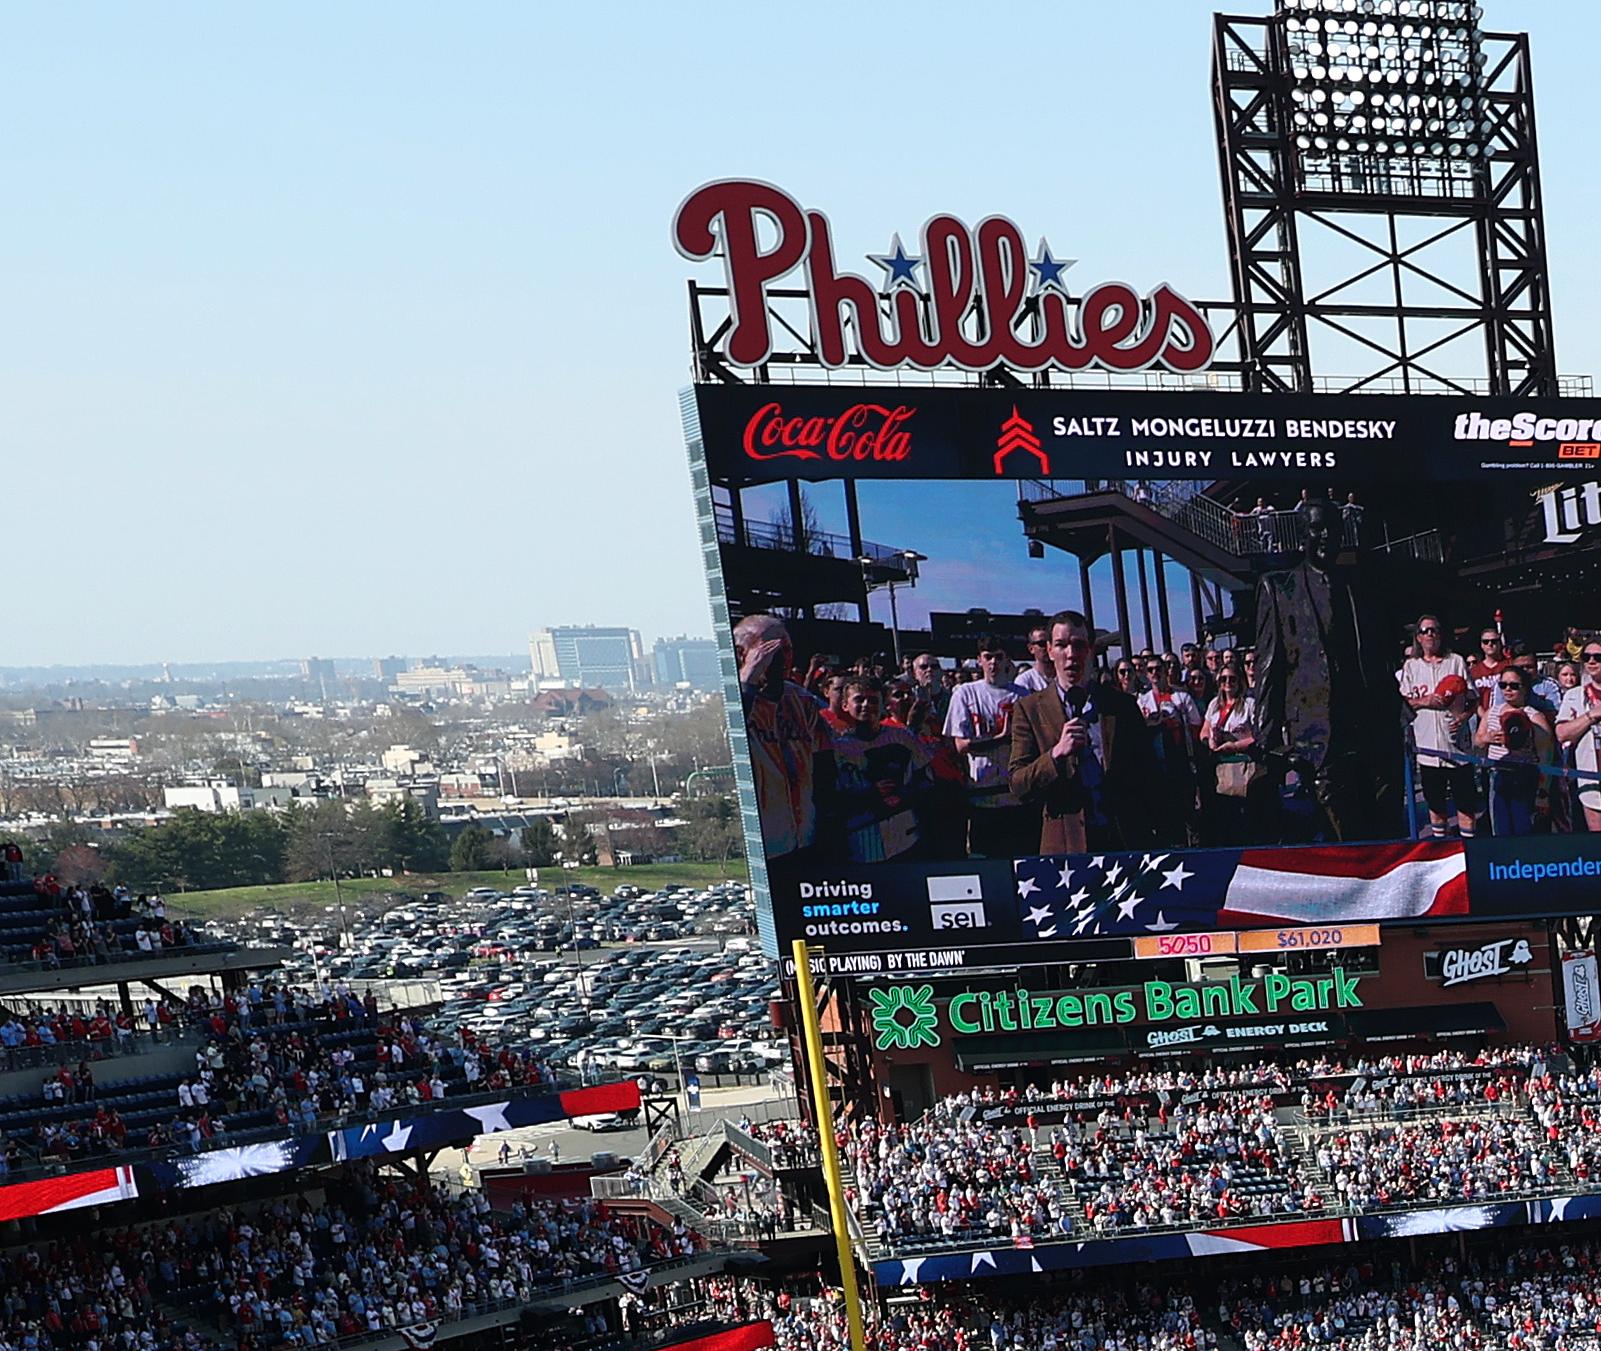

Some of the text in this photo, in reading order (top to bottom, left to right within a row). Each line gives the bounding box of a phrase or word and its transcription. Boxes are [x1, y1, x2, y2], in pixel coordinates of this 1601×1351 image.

[672, 176, 1217, 374] Phillies
[743, 402, 917, 461] Coca-Cola
[1053, 416, 1396, 440] SALTZ MONGELUZZI BENDESKY
[1126, 450, 1336, 468] INJURY LAWYERS
[1563, 443, 1598, 457] BET
[800, 880, 872, 899] Driving
[802, 901, 880, 918] smarter
[805, 919, 909, 937] outcomes.
[1277, 929, 1343, 948] $61,020
[785, 954, 827, 976] (MSIC
[829, 953, 882, 974] PLAYING)
[887, 953, 903, 969] BY
[904, 952, 927, 968] THE
[1442, 940, 1514, 988] GHOST
[947, 966, 1365, 1035] Citizens Bank Park
[1226, 1024, 1285, 1039] ENERGY
[1289, 1021, 1329, 1035] DECK
[1014, 1105, 1046, 1116] OFFICIAL
[1046, 1103, 1074, 1113] ENERGY
[1074, 1101, 1096, 1111] DRINK
[1096, 1101, 1106, 1109] OF
[1105, 1100, 1116, 1108] THE
